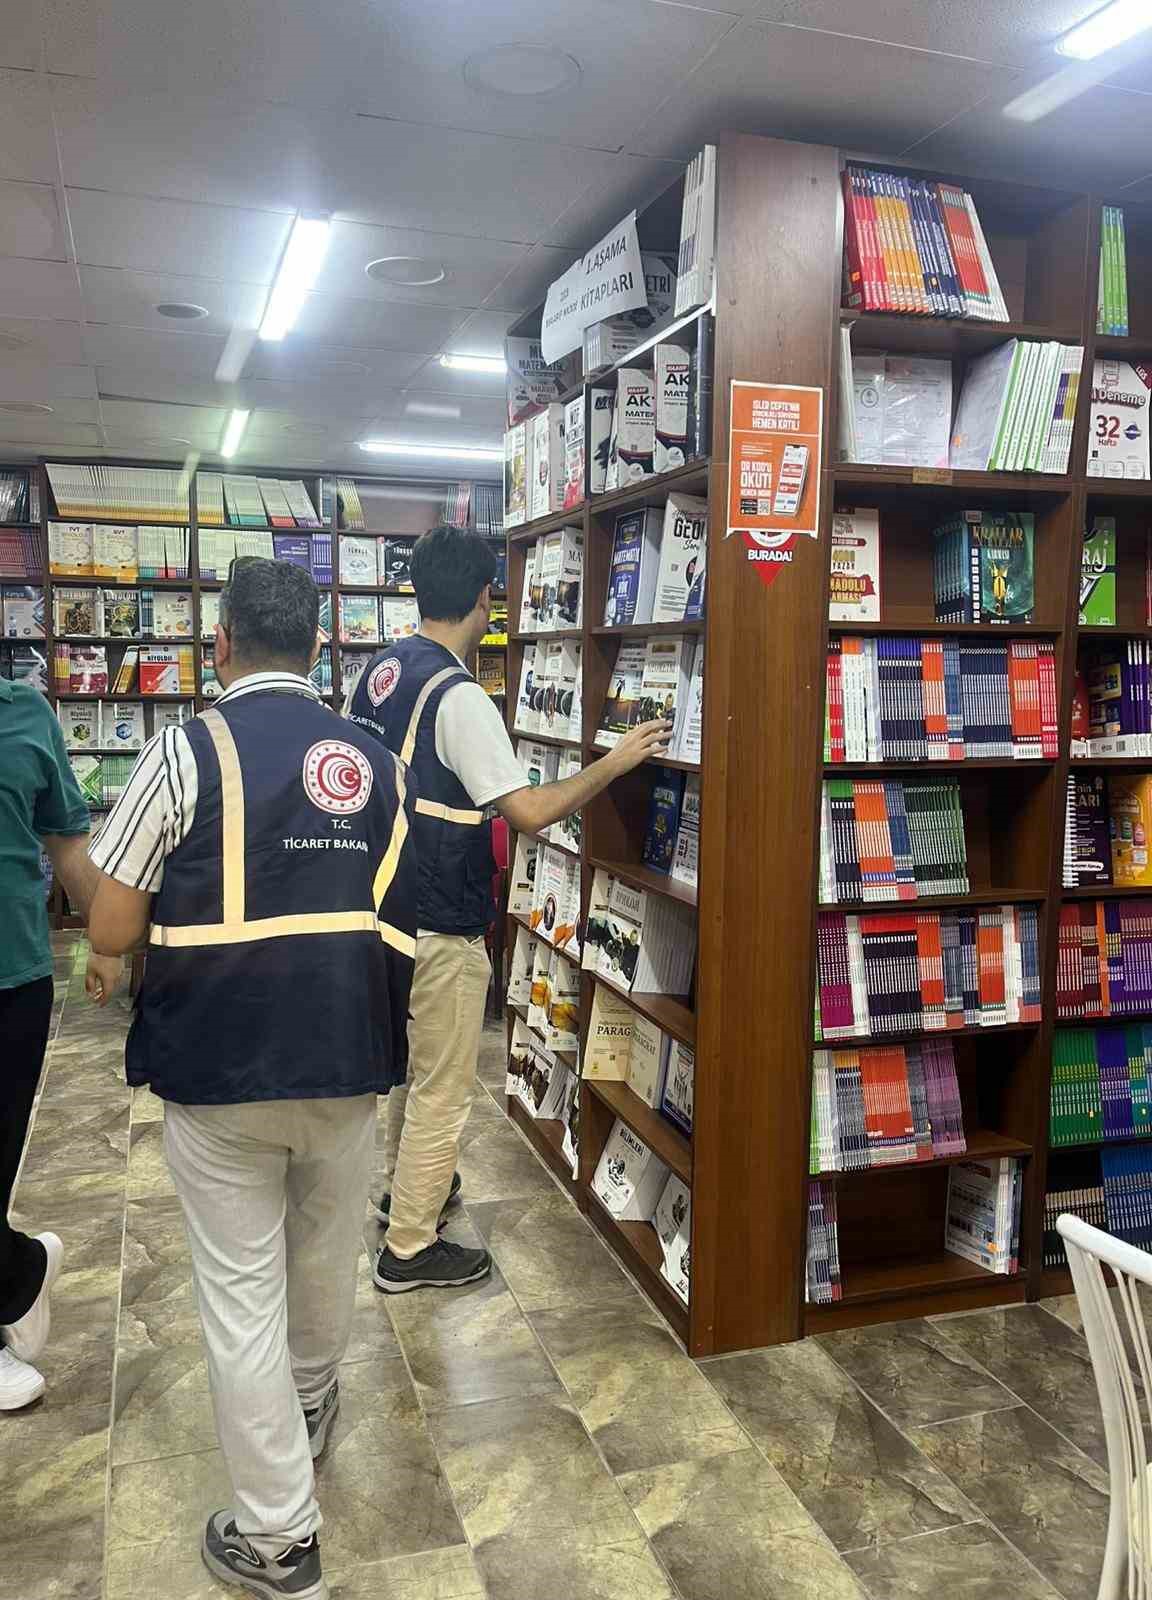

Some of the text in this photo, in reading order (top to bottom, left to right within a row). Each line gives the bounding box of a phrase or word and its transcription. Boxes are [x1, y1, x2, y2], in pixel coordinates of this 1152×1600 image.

[580, 271, 634, 311] KİTAPLARI
[626, 395, 655, 408] AK
[1099, 388, 1145, 409] Deneme
[1096, 415, 1120, 439] 32
[747, 549, 793, 562] BURADA!
[331, 819, 352, 830] T.C.
[282, 837, 332, 850] TİCARET
